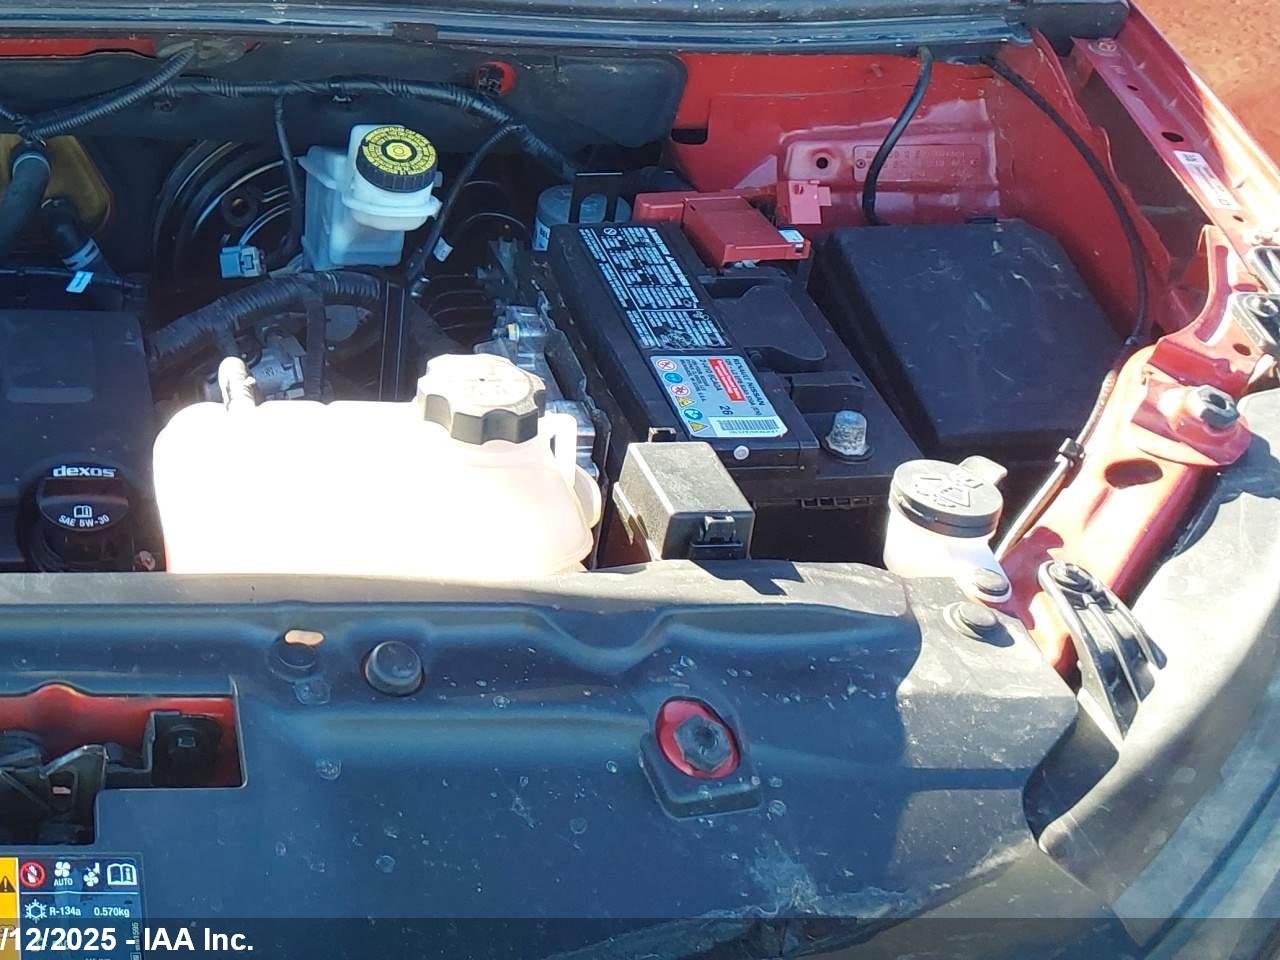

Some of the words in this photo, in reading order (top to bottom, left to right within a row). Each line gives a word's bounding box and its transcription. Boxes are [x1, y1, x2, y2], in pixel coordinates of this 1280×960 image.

[747, 382, 765, 406] NISSAN
[720, 405, 734, 415] 26
[52, 465, 116, 477] dexos
[58, 515, 76, 526] SAE
[54, 878, 73, 887] AUTO
[49, 906, 81, 916] R-134a
[94, 907, 130, 918] 0.570kg
